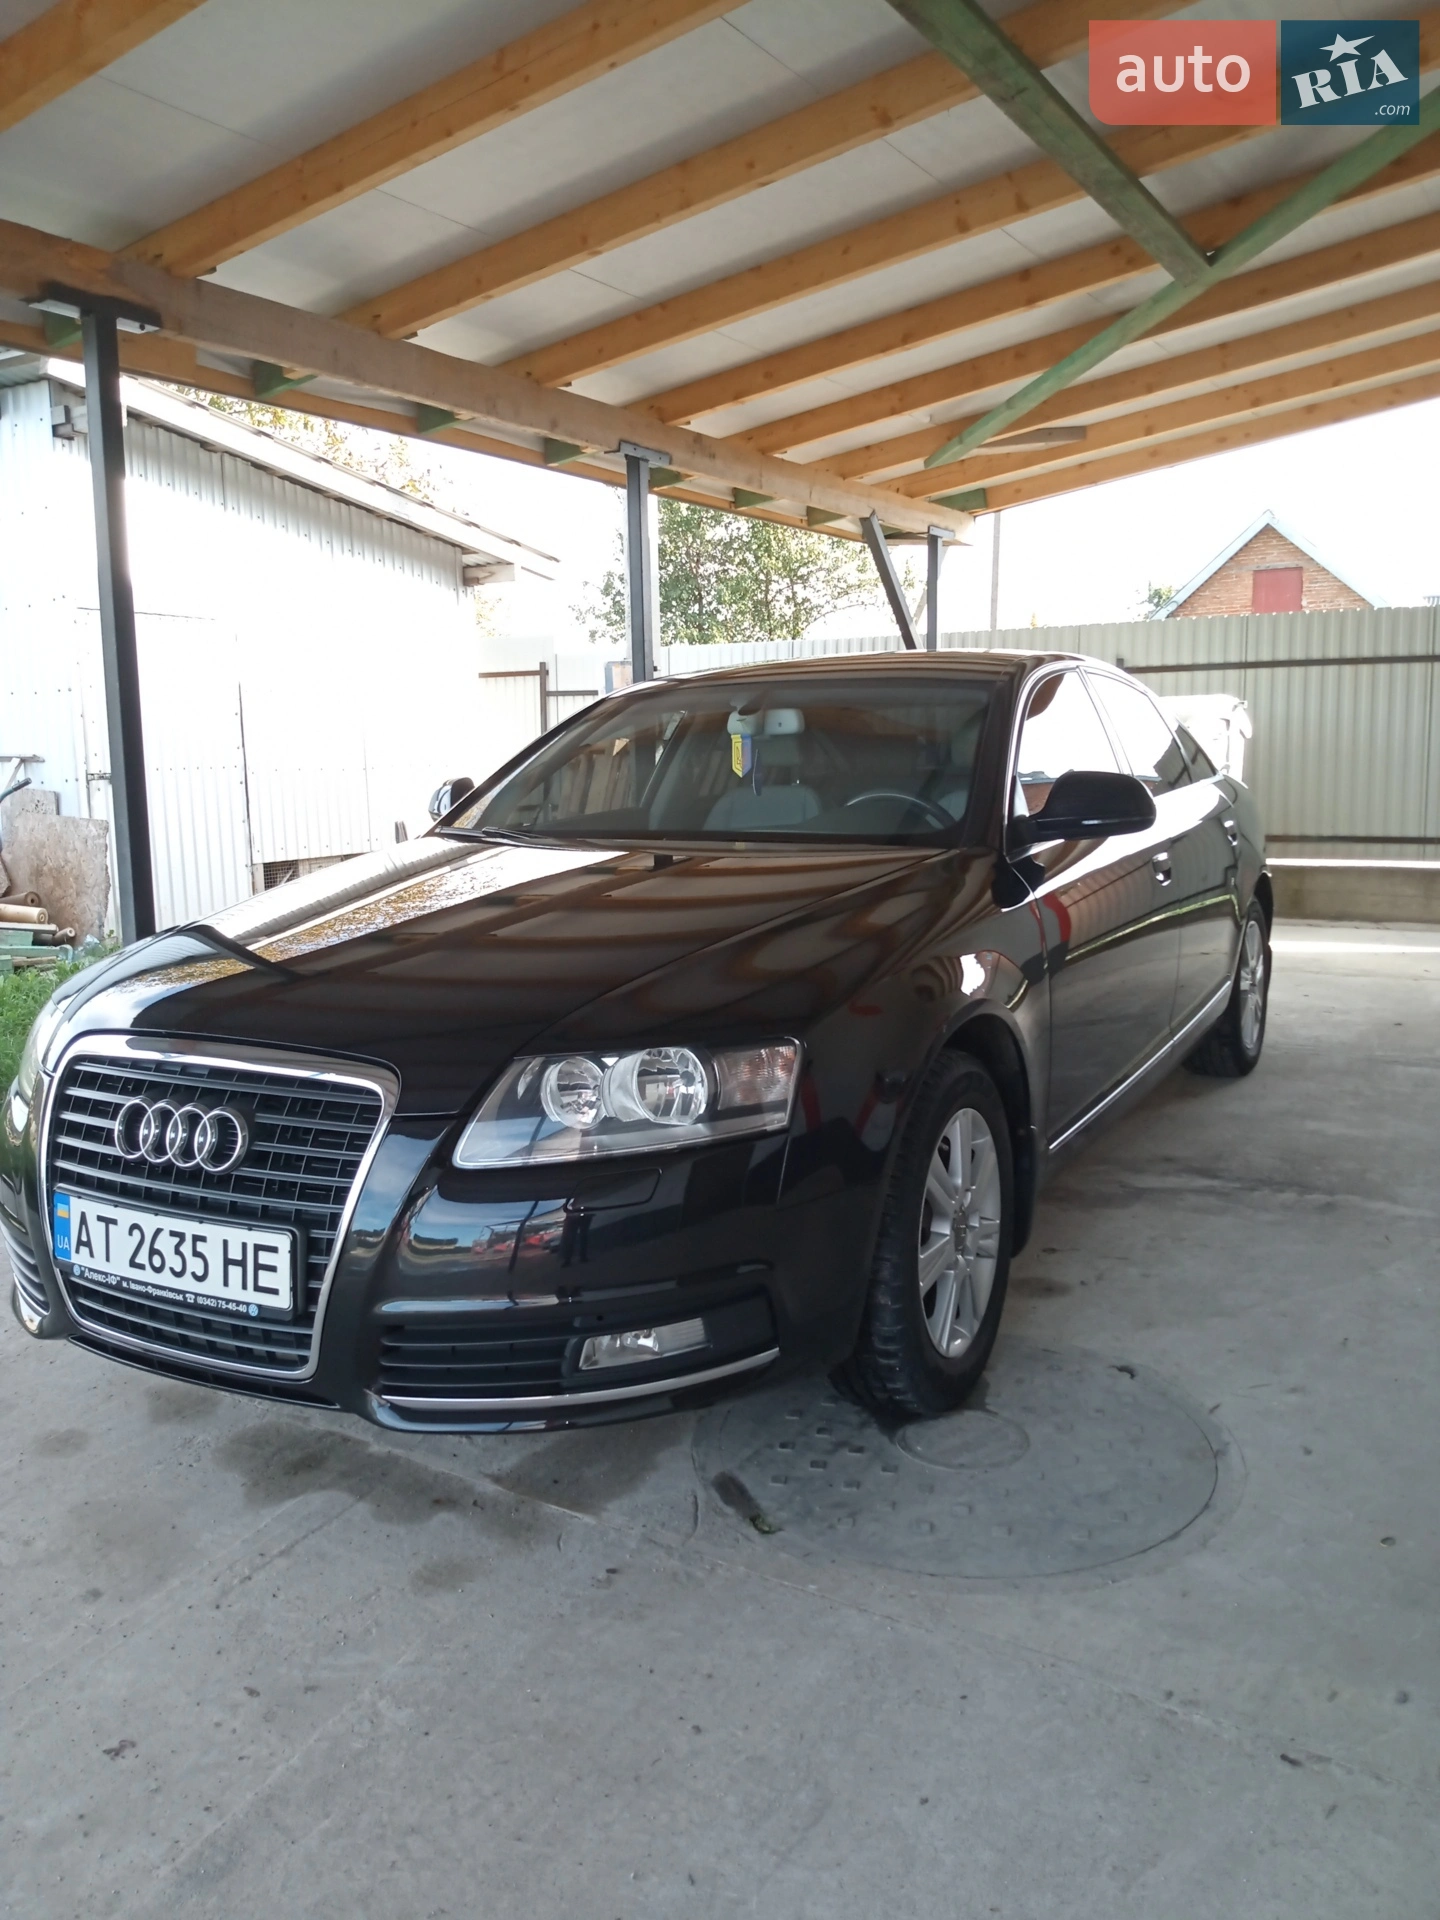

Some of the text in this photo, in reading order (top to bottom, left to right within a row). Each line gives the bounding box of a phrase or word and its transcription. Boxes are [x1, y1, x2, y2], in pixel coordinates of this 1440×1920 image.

[57, 1236, 70, 1251] UA
[74, 1211, 280, 1296] AT 2635 HE
[217, 1300, 247, 1313] 75-45-40
